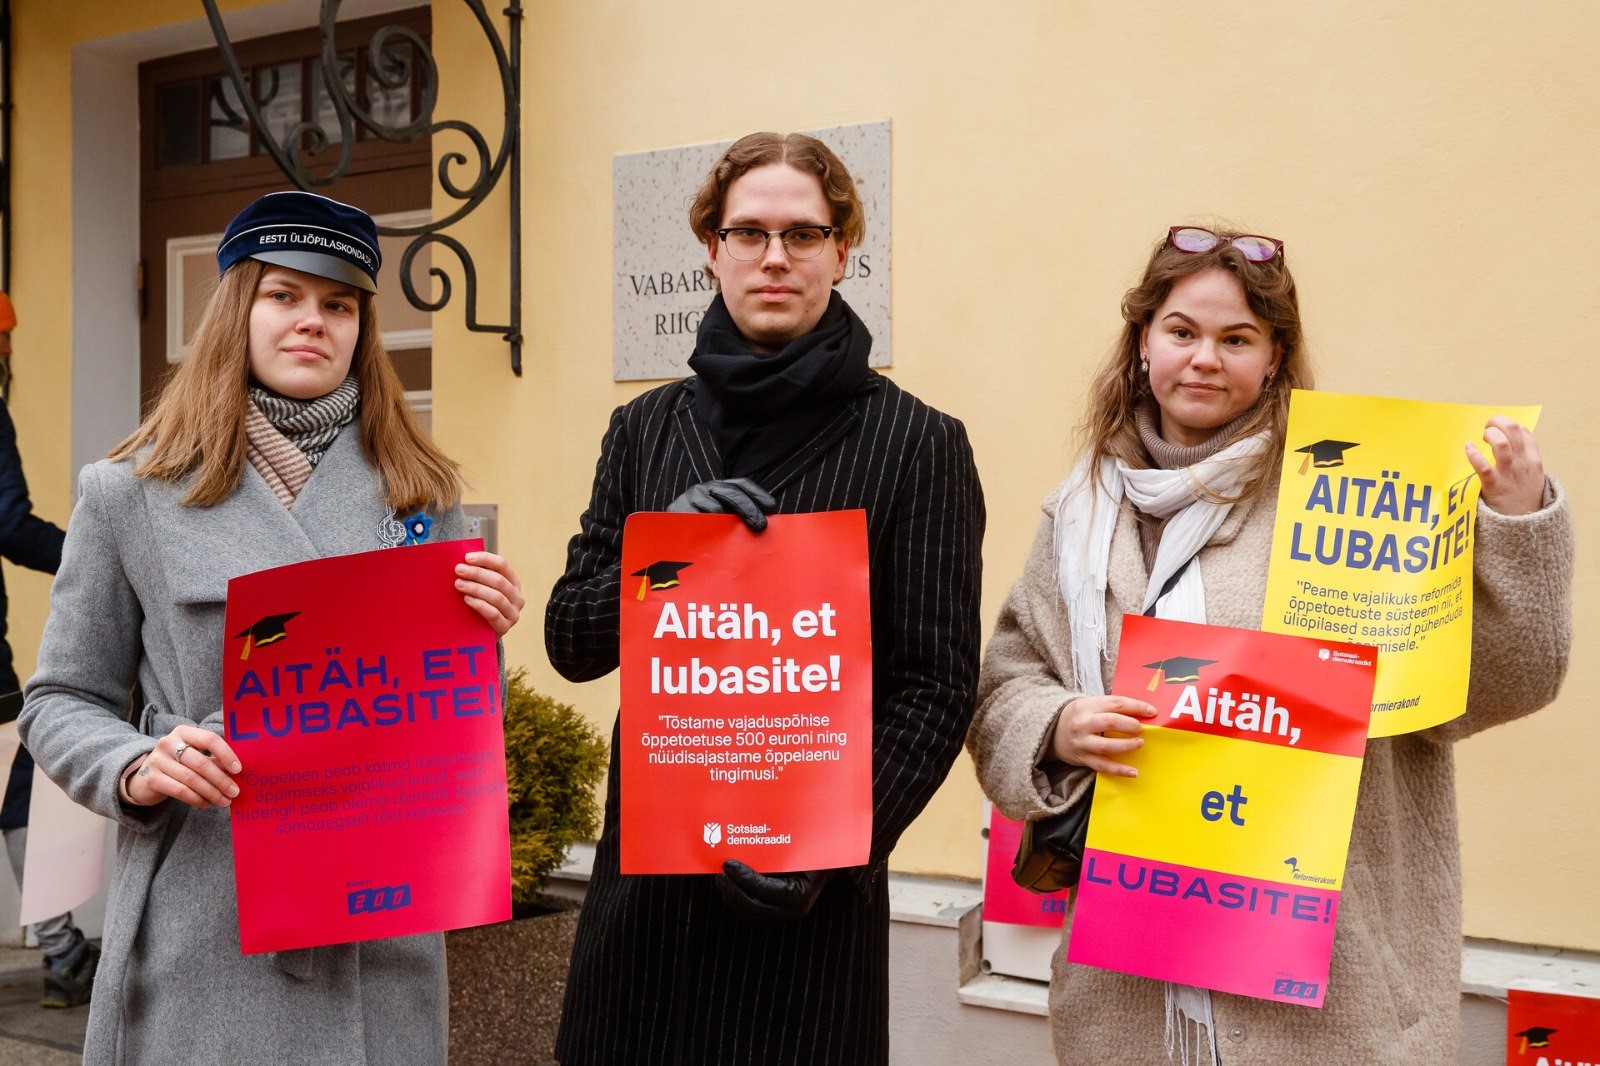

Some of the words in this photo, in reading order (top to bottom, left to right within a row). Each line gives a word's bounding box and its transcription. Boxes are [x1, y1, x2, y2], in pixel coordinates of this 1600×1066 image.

[260, 234, 287, 244] EESTI
[655, 310, 706, 335] RIIG
[1304, 470, 1440, 531] AITÄH,
[1290, 510, 1470, 574] LUBASITE!
[1289, 596, 1382, 620] õppetoetuste
[1385, 604, 1439, 621] süsteemi
[1441, 596, 1454, 610] nii,
[1455, 590, 1463, 602] et
[1296, 580, 1349, 601] "Peame
[1352, 591, 1418, 607] vajalikuks
[1420, 576, 1462, 603] reformida
[652, 602, 781, 646] Aitäh,
[792, 602, 837, 639] et
[1283, 612, 1357, 635] üliõpilased
[1361, 623, 1411, 637] saaksid
[1414, 606, 1463, 637] pühenduda
[233, 646, 400, 702] AITÄH,
[422, 645, 486, 681] ET
[651, 655, 841, 695] lubasite!
[228, 684, 497, 741] LUBASITE!
[1169, 685, 1302, 745] Aitäh,
[1370, 694, 1421, 712] ormierakond
[658, 714, 725, 730] "Tõstame
[727, 713, 830, 731] vajaduspõhise
[641, 732, 732, 750] õppetoetuse
[735, 732, 765, 746] 500
[768, 731, 813, 746] euroni
[817, 731, 847, 746] ning
[324, 763, 361, 780] peab
[648, 749, 762, 767] nüüdisajastame
[765, 748, 840, 766] õppelaenu
[709, 766, 784, 784] tingimusi."
[300, 799, 339, 818] peab
[1200, 784, 1248, 827] et
[726, 823, 772, 835] Sotsiaal-
[726, 834, 791, 846] demokraadid
[1086, 857, 1332, 924] LUBASITE!
